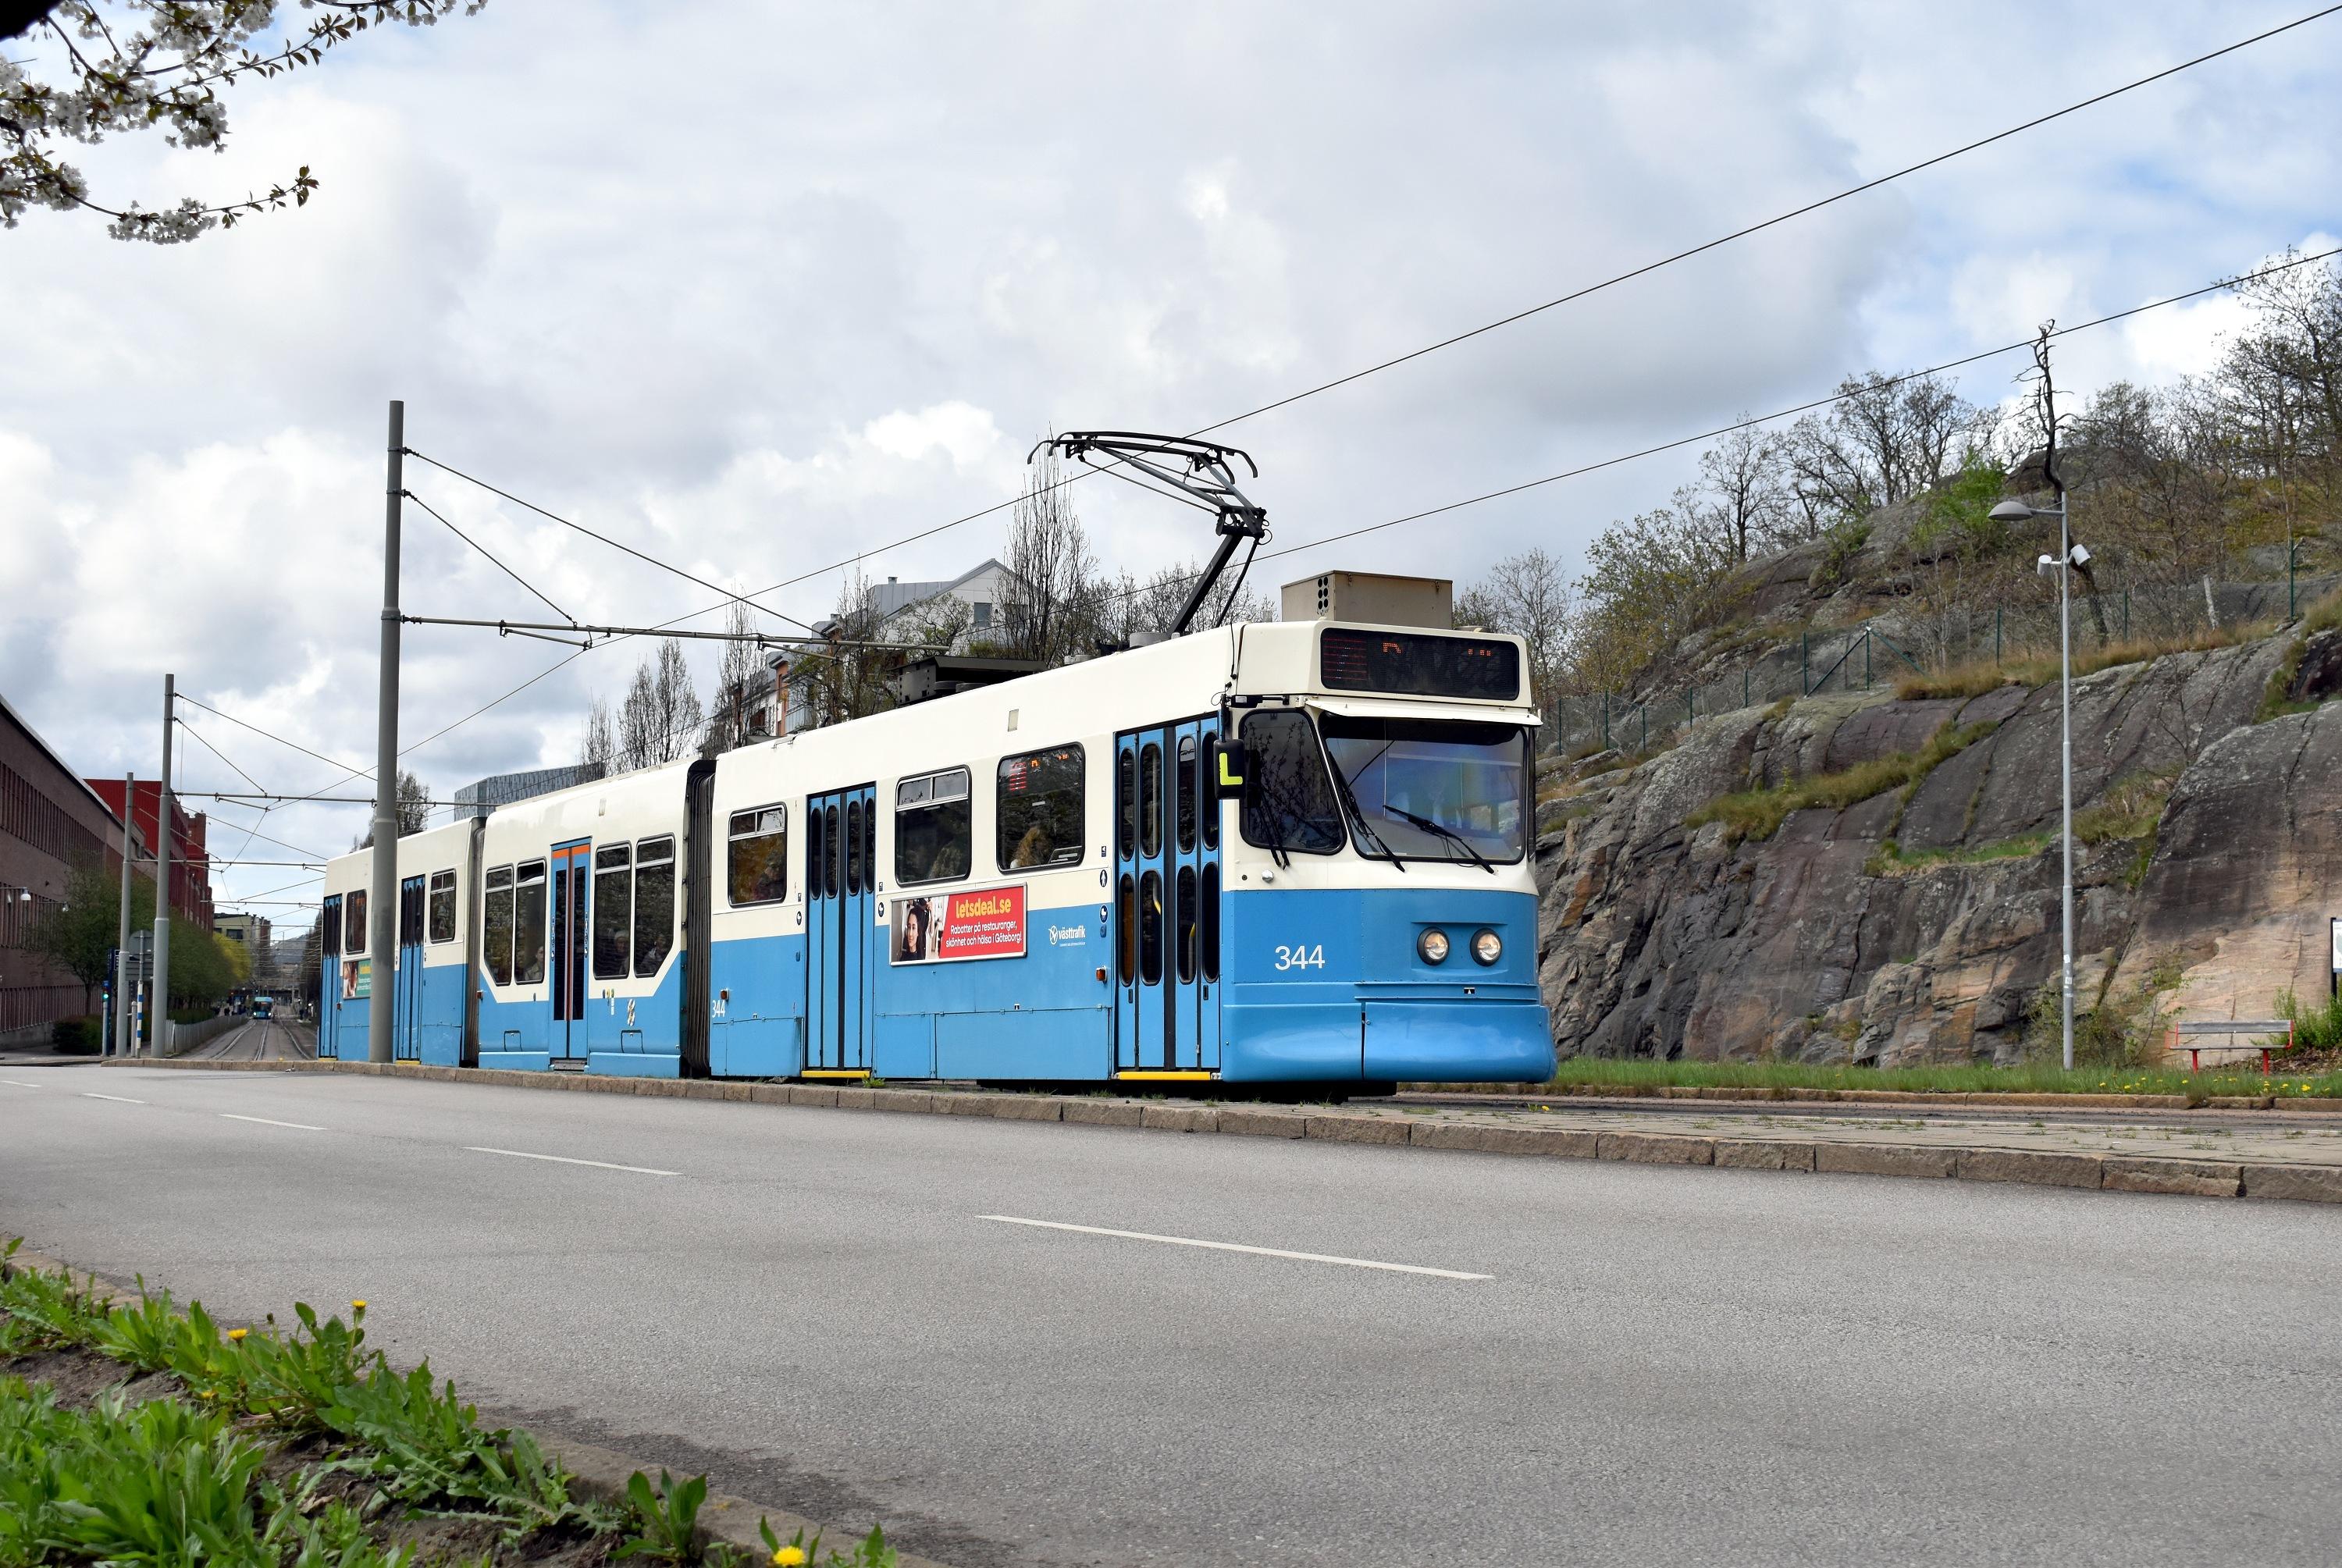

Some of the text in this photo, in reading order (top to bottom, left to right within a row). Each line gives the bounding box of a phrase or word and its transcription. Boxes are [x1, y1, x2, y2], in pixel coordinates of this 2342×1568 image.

[956, 896, 1012, 919] letsdeal.se
[950, 920, 1017, 935] Rabatter på restauranger,
[1058, 925, 1086, 940] västtrafik
[945, 937, 966, 948] skönhet
[966, 935, 977, 946] och
[977, 933, 992, 944] hälsa
[995, 931, 1022, 944] Göteborg!
[1275, 944, 1326, 971] 344
[711, 999, 726, 1019] 344
